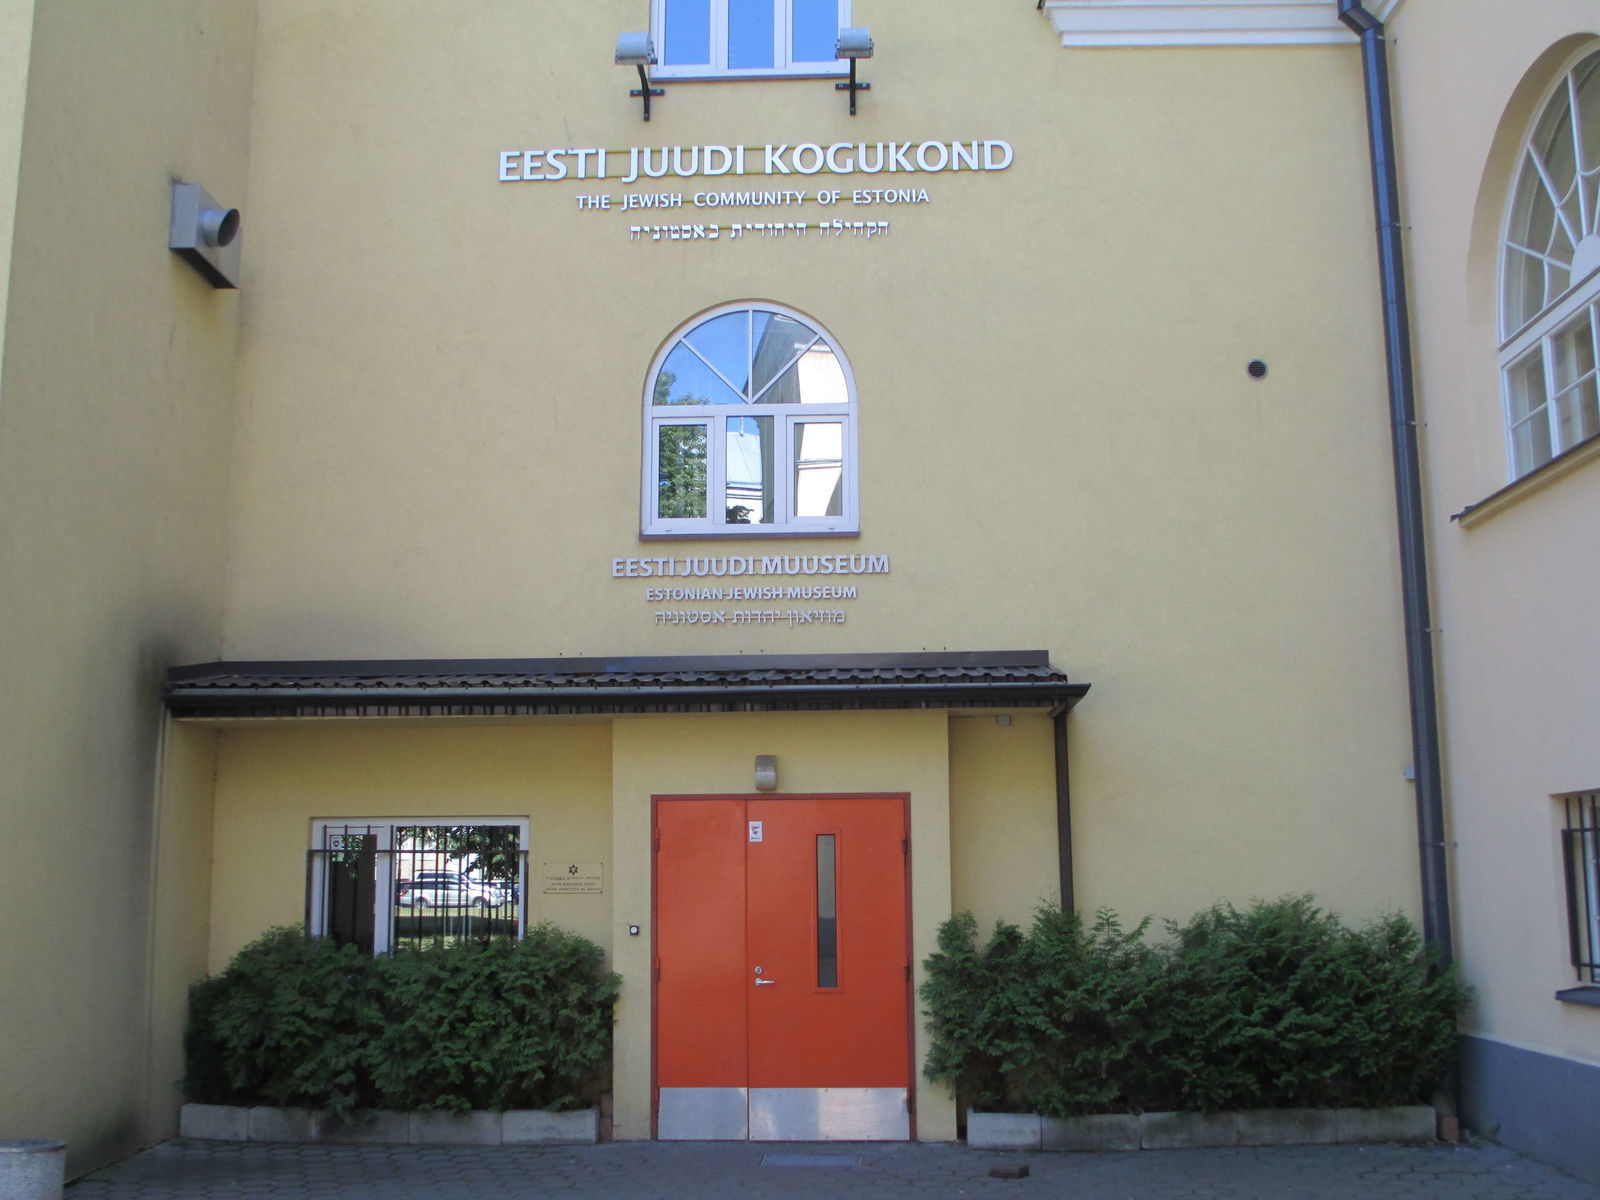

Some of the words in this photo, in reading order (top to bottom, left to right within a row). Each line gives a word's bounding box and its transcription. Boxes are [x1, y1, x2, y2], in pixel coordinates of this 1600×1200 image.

[499, 148, 606, 181] EESTI
[621, 145, 744, 183] JUUDI
[764, 141, 1013, 175] KOGUKOND
[576, 194, 611, 209] THE
[620, 193, 682, 211] JEWISH
[693, 191, 806, 207] COMMUNITY
[817, 190, 840, 205] OF
[852, 188, 930, 204] ESTONIA
[730, 222, 807, 239] היהודית
[819, 218, 889, 239] הקהילה
[611, 557, 675, 577] EESTI
[680, 555, 754, 576] JUUDI
[761, 553, 890, 575] MUUSEUM
[646, 587, 723, 601] ESTONIAN
[726, 586, 783, 600] JEWISH
[787, 585, 857, 599] MUSEUM
[655, 610, 726, 624] אסטוניה
[732, 609, 781, 624] יהדות
[787, 609, 845, 629] מוזיאון
